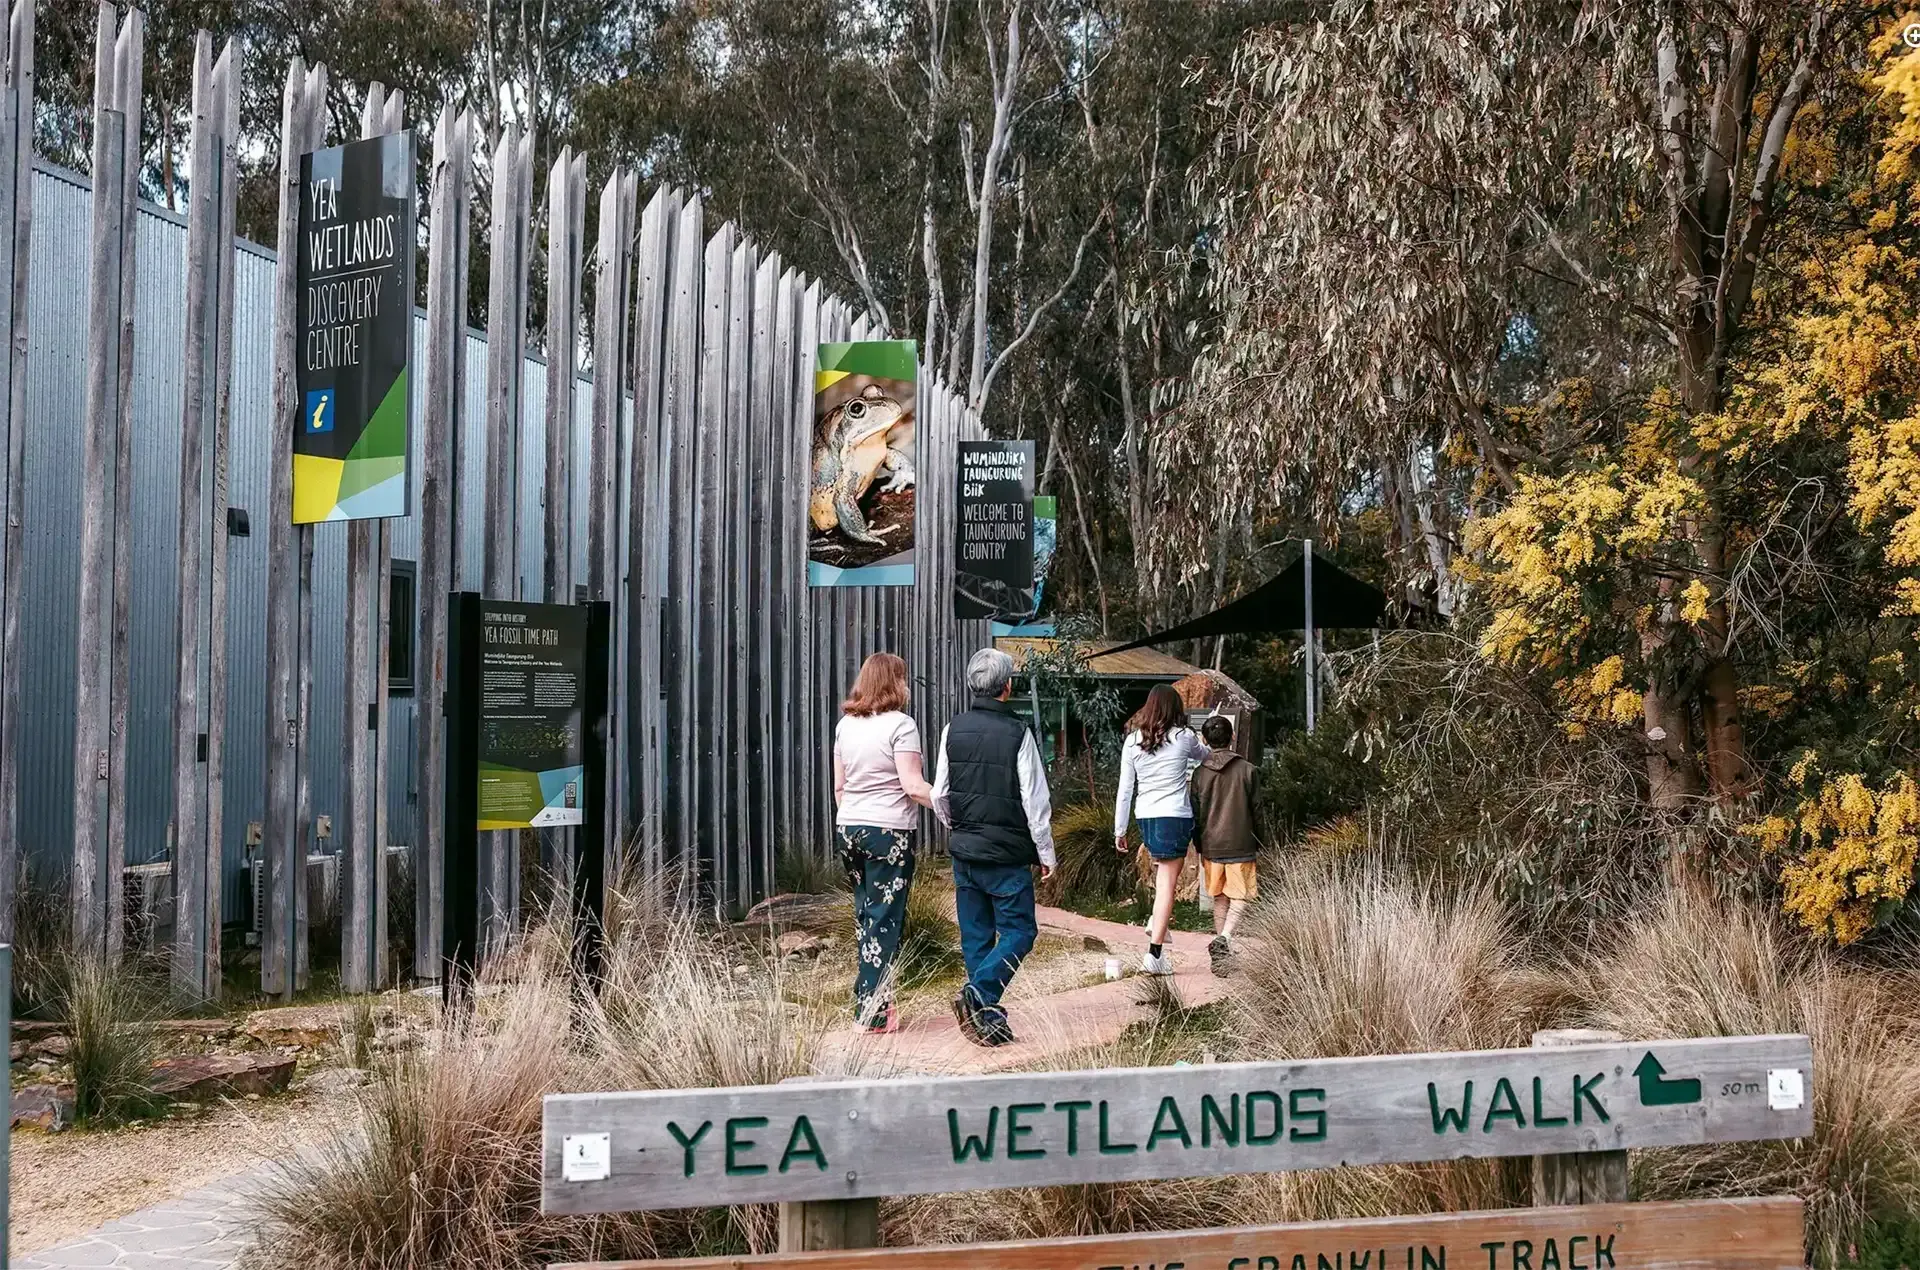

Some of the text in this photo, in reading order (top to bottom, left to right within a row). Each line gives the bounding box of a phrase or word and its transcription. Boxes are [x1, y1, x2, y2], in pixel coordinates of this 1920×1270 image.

[310, 176, 337, 222] YEA
[309, 214, 395, 272] WETLANDS
[308, 275, 382, 327] DISCOVERY
[307, 323, 360, 371] CENTRE
[963, 467, 1024, 481] TAUNGURUNG
[963, 503, 1024, 521] WELCOME TO
[963, 522, 1026, 541] TAUNGURUNG
[963, 542, 1007, 560] COUNTRY
[484, 626, 559, 646] YEA FOSSIL TIME PATH
[666, 1071, 1610, 1178] YEA WETLANDS WALK
[1481, 1234, 1616, 1270] TRACK
